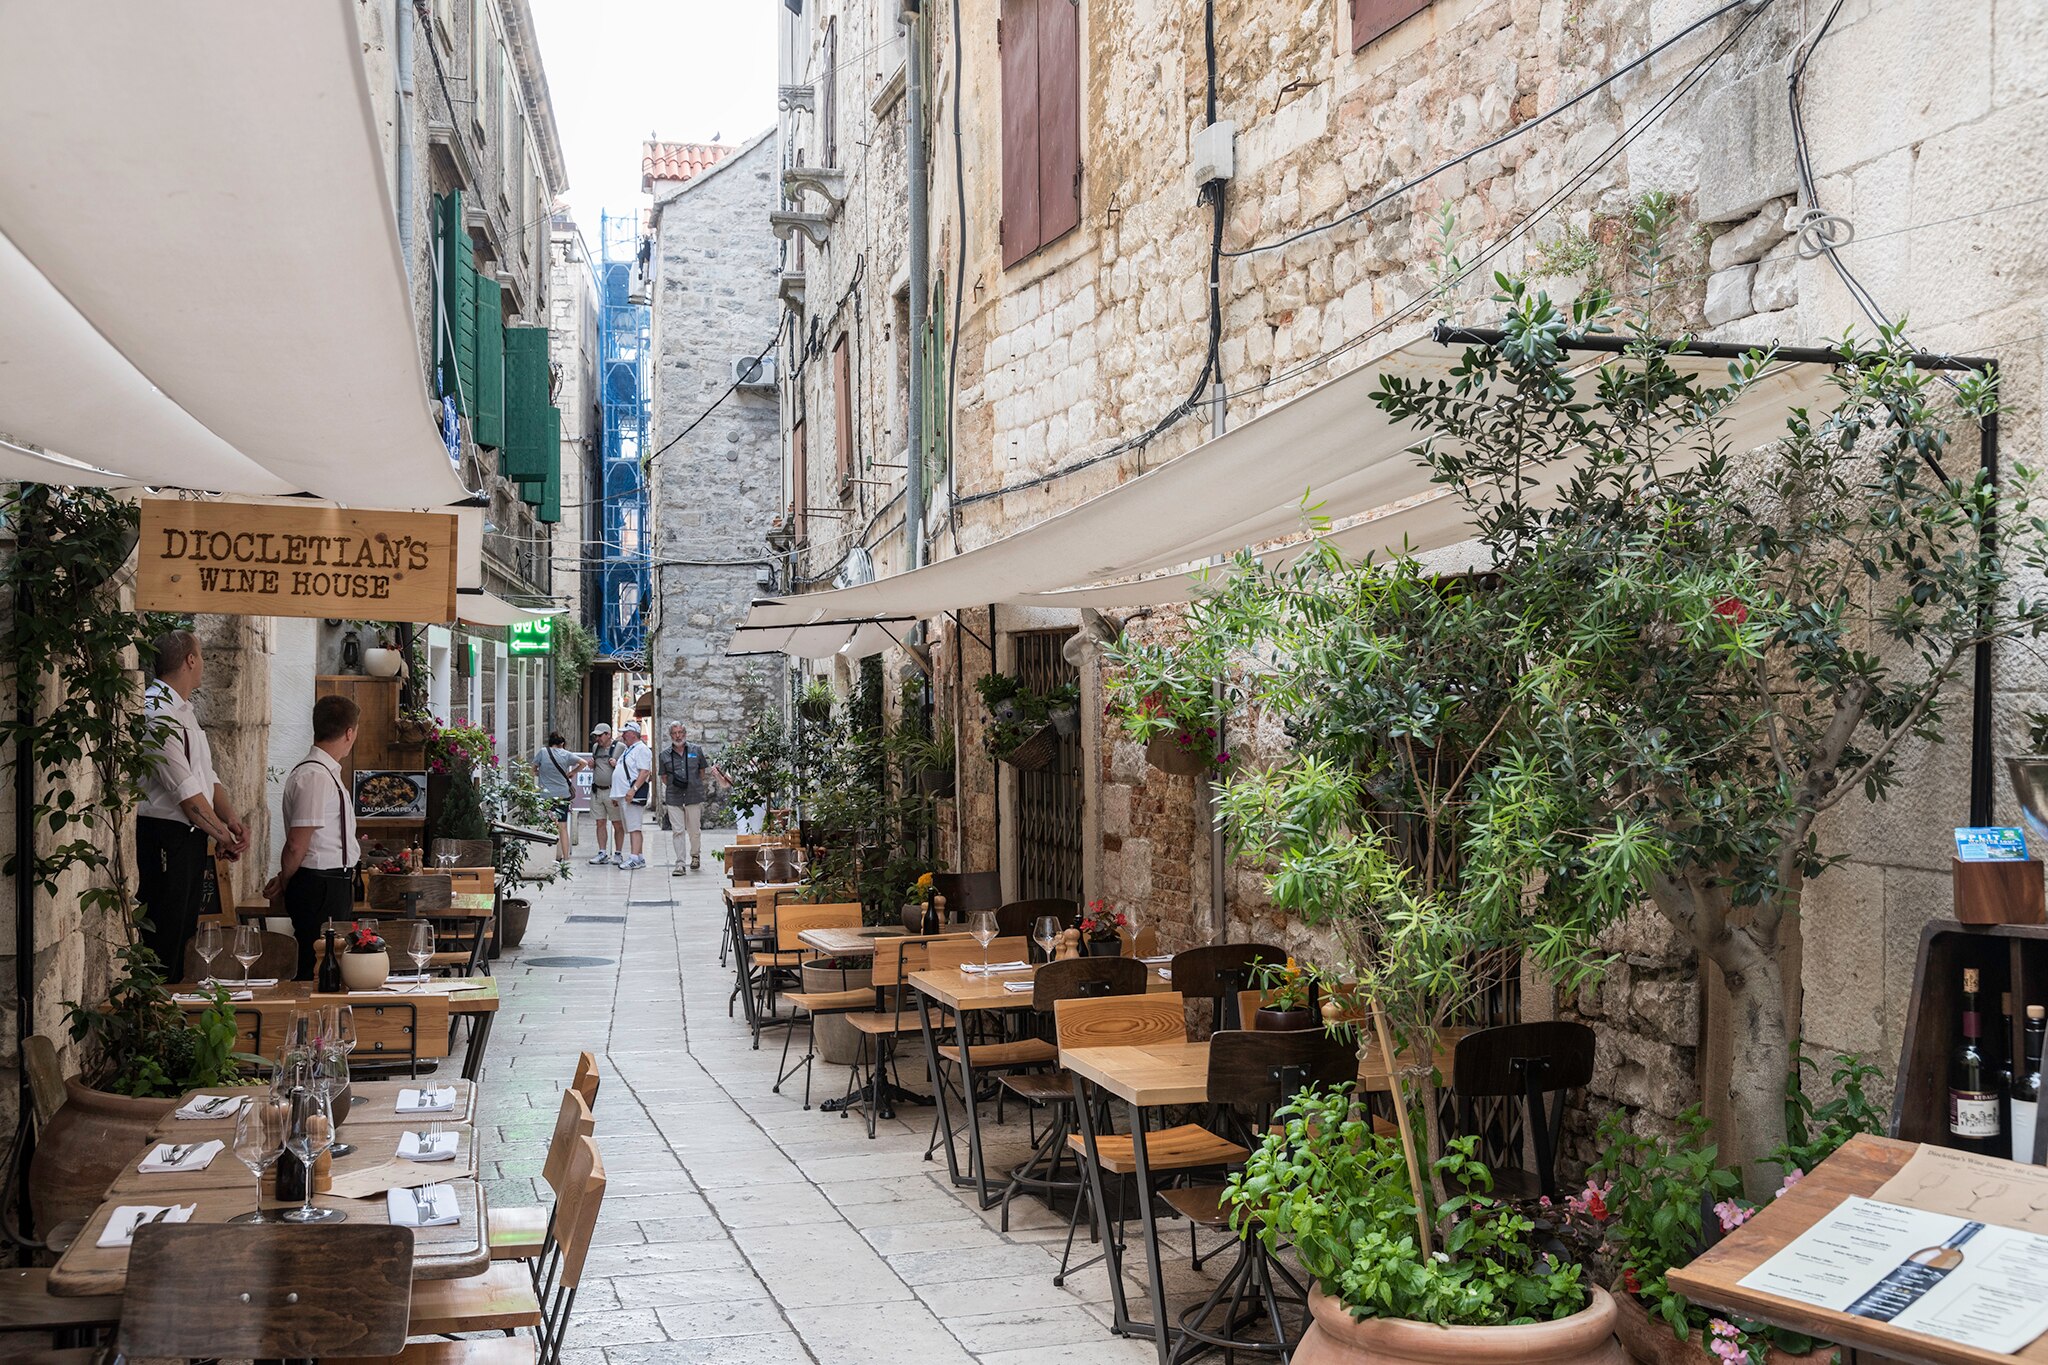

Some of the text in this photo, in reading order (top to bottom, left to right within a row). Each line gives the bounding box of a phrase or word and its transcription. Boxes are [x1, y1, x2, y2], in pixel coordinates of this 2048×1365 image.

[160, 528, 429, 570] DIOCLETIAN'S
[199, 567, 390, 599] WINE HOUSE
[513, 617, 551, 633] WC
